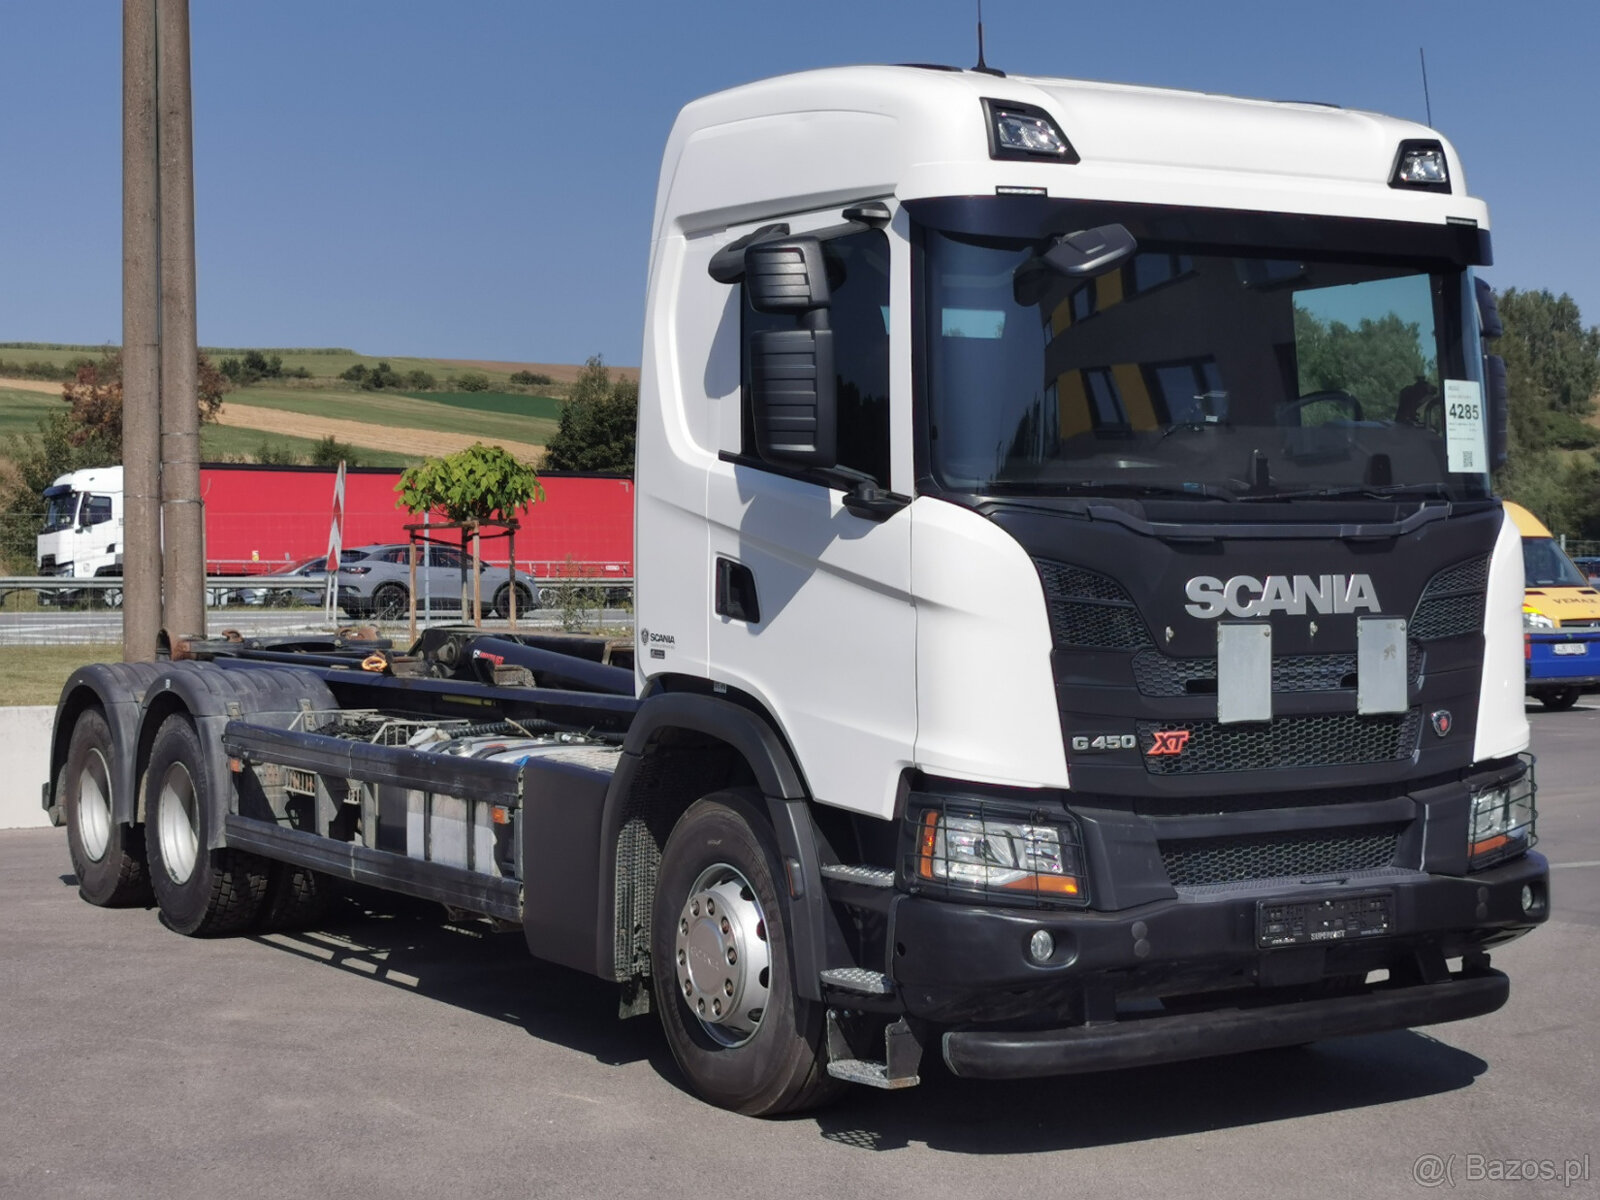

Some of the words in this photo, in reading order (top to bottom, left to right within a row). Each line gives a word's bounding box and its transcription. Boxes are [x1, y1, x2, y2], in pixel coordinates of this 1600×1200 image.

[1449, 403, 1480, 420] 4285
[1184, 574, 1382, 619] SCANIA
[650, 632, 675, 644] SCANIA
[1072, 736, 1089, 750] G
[1091, 734, 1136, 750] 450
[1147, 731, 1190, 756] XT
